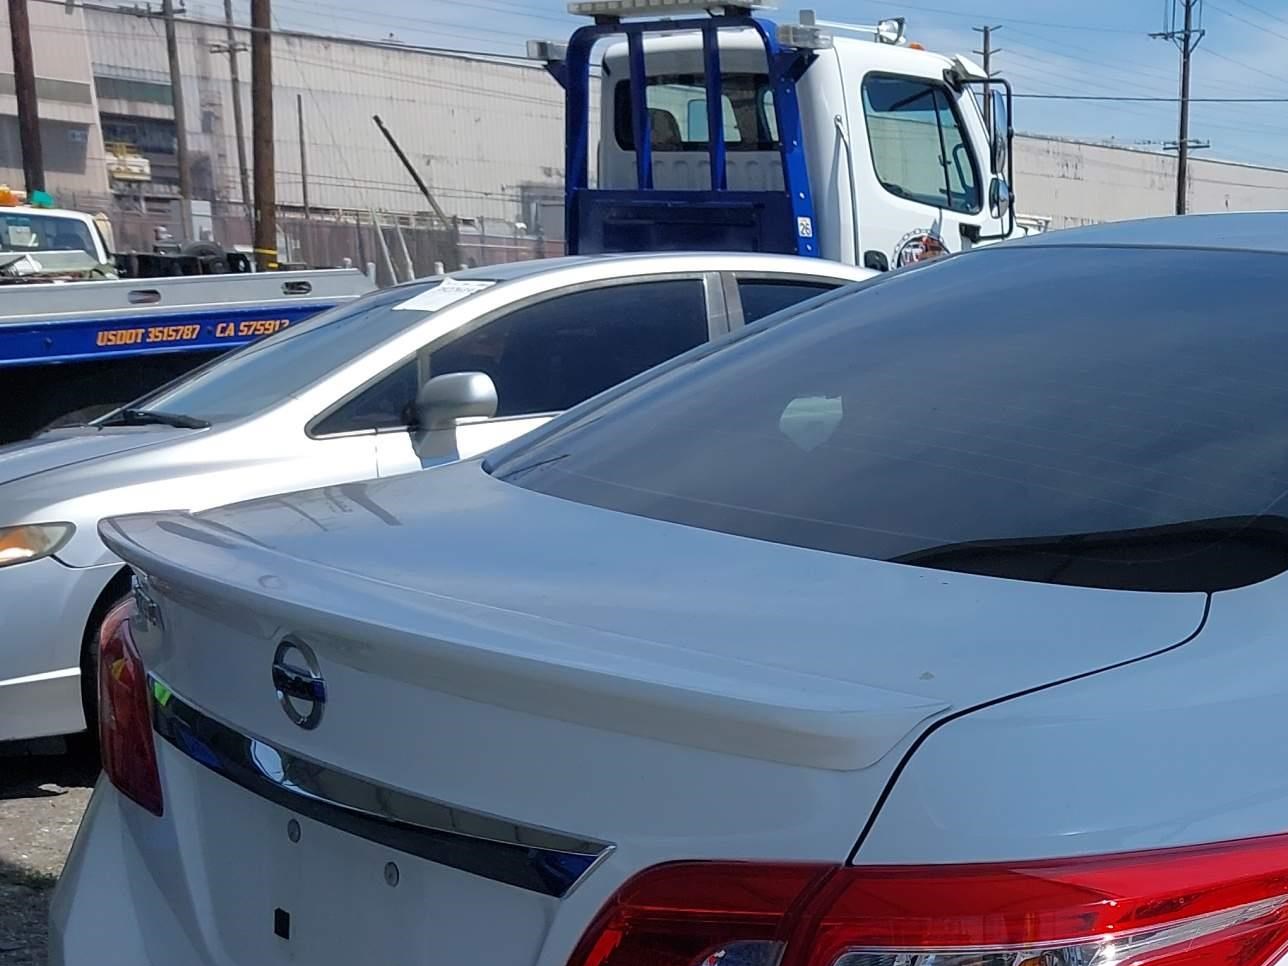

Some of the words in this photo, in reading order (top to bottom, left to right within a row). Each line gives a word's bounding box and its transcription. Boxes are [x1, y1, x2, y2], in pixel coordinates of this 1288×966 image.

[799, 222, 811, 236] 26
[96, 329, 144, 346] USDOT
[146, 324, 200, 342] 3515787
[215, 322, 235, 338] CA
